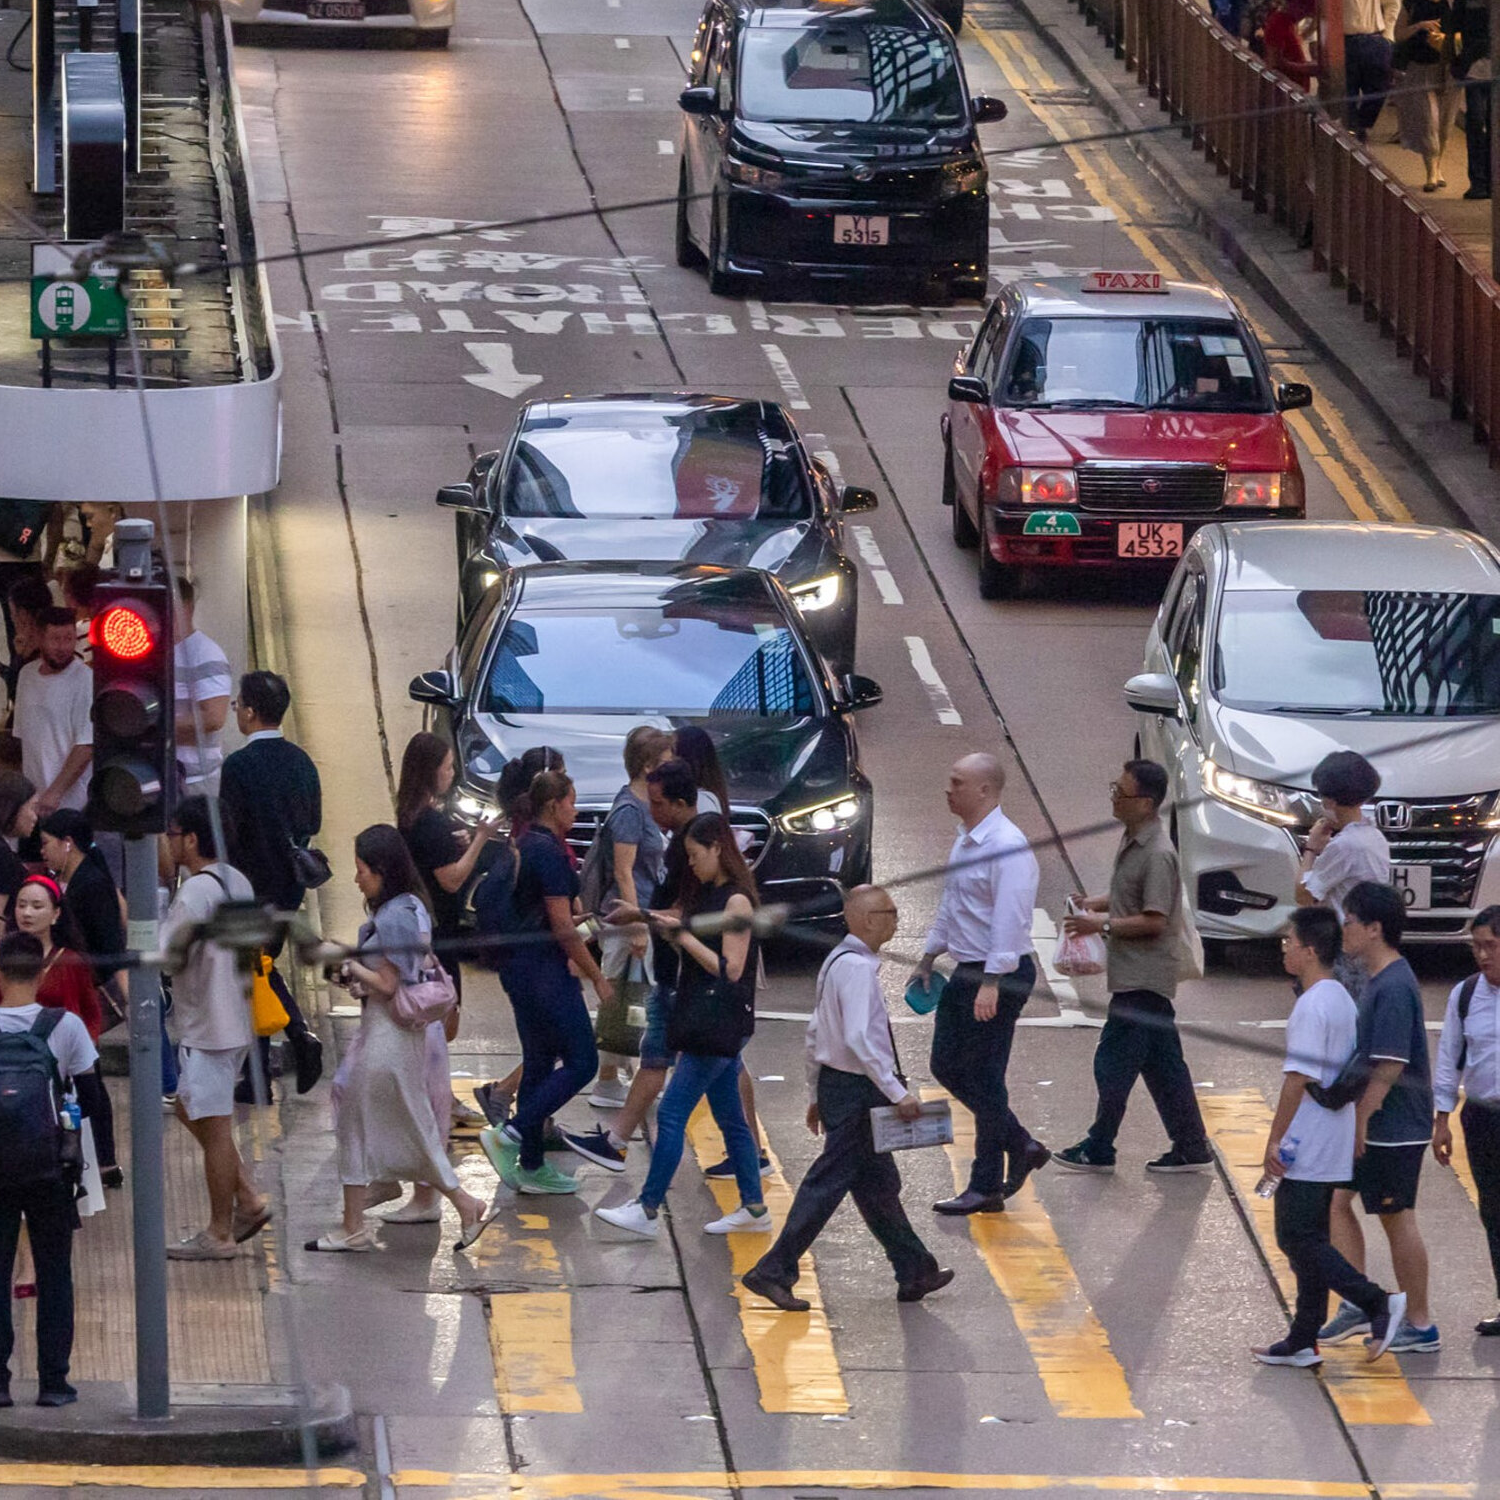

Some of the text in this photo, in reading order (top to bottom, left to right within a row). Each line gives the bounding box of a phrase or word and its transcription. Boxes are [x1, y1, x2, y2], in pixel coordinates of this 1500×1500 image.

[851, 218, 872, 231] YT
[842, 230, 884, 245] 5315
[1093, 272, 1161, 291] TAXI
[1046, 515, 1057, 527] 4
[1137, 524, 1163, 540] UK
[1124, 540, 1178, 556] 4532
